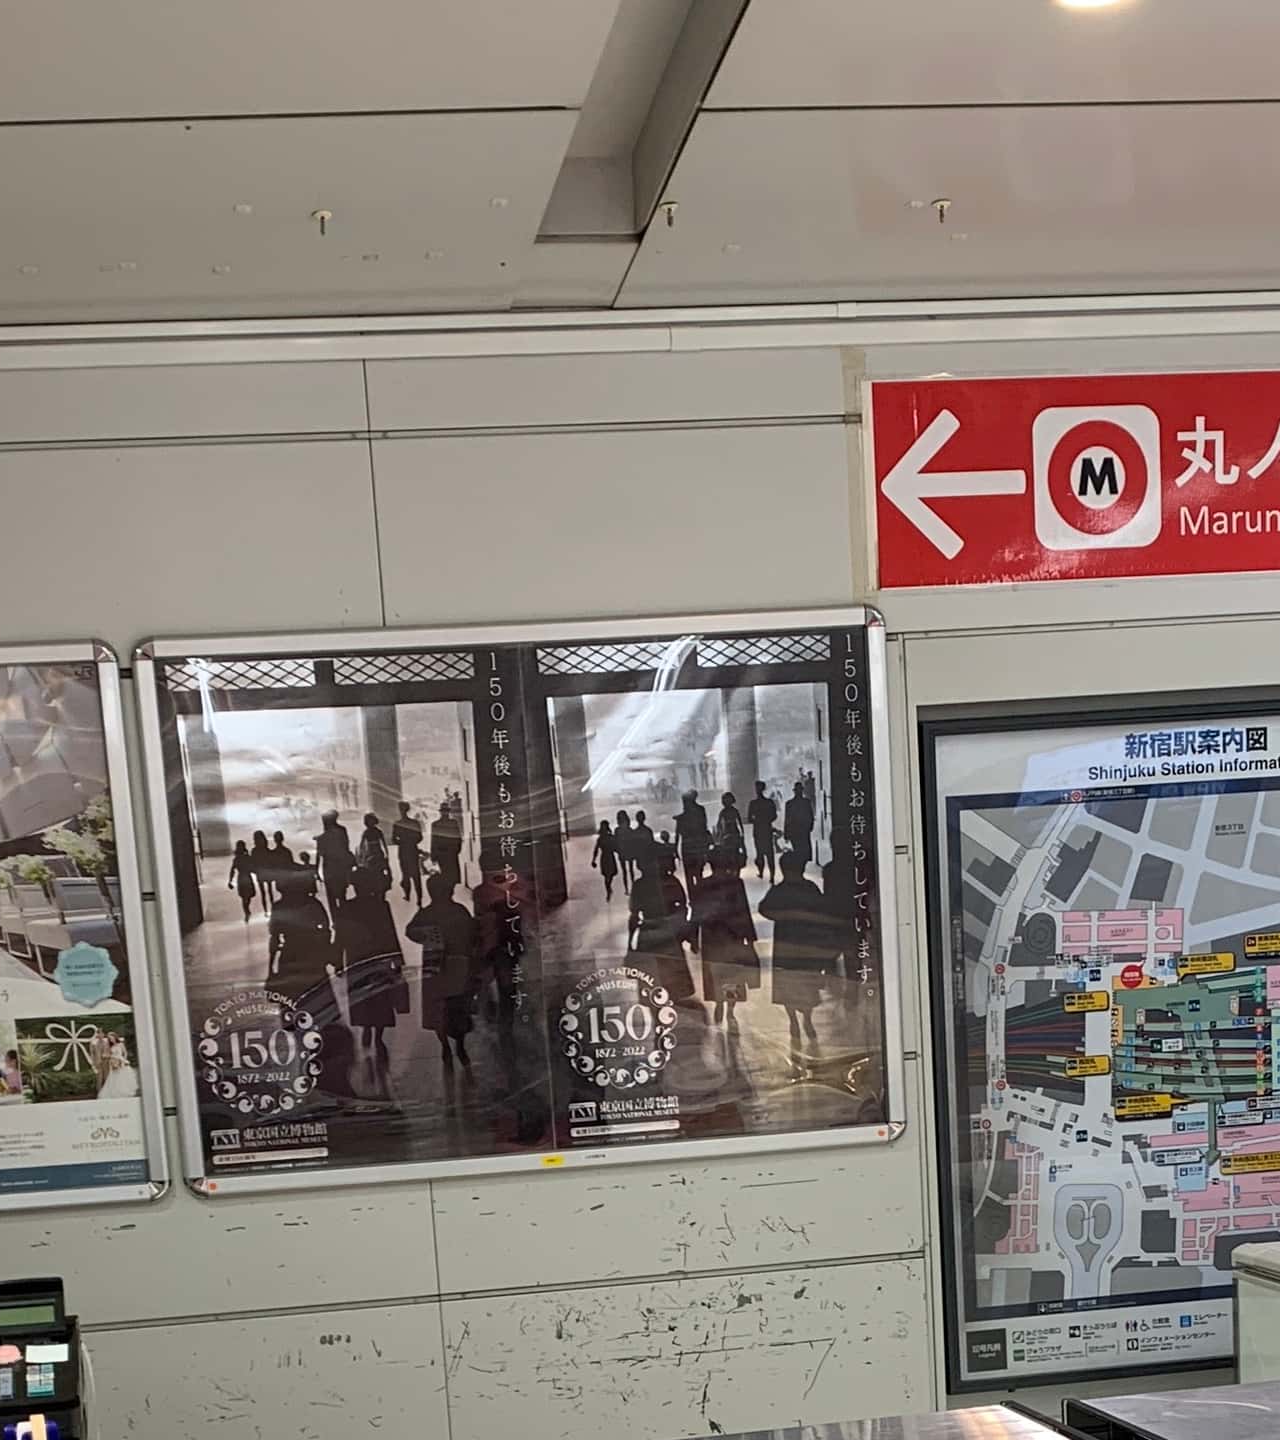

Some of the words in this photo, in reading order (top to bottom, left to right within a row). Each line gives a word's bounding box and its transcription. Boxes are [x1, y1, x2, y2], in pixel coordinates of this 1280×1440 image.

[1125, 727, 1268, 760] 新宿駅案内図
[1088, 766, 1156, 782] Shinjuku
[1161, 762, 1215, 777] Station
[842, 632, 876, 998] 150年後もお待ちしています。
[588, 1003, 652, 1044] 150
[229, 1028, 297, 1069] 150
